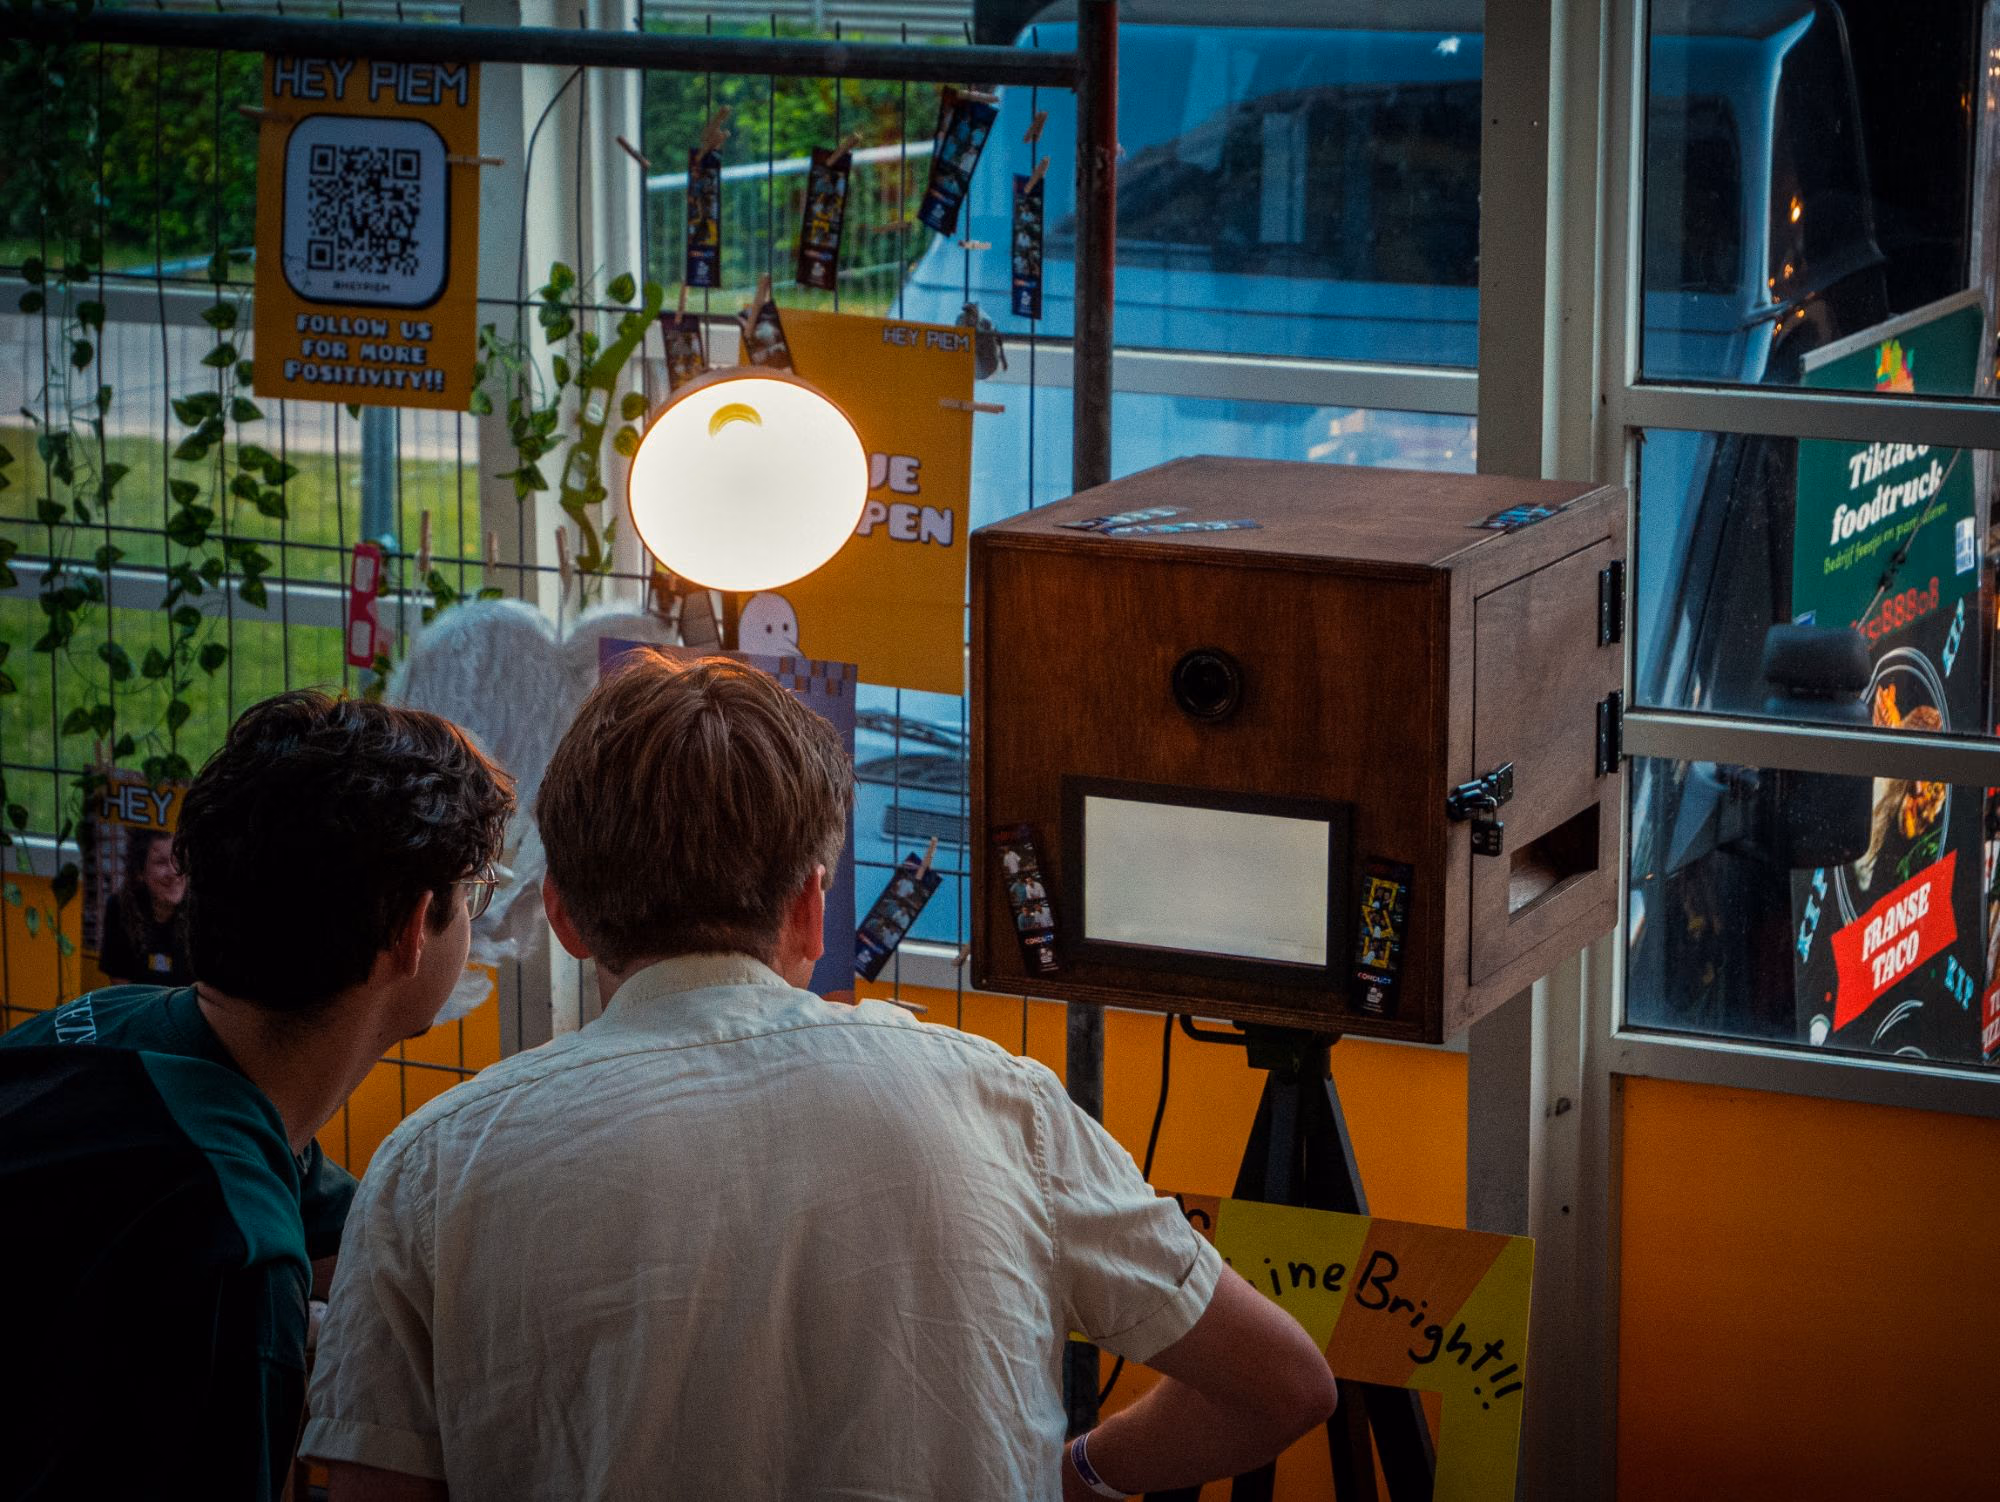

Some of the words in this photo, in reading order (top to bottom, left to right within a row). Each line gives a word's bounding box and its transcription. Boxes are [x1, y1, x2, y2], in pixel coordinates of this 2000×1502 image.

[272, 56, 355, 99] HEY
[369, 61, 469, 107] PIEM
[296, 313, 389, 338] FOLLOW
[400, 321, 433, 341] US
[883, 327, 919, 346] HEY
[302, 339, 348, 359] FOR
[360, 343, 427, 365] MORE
[284, 359, 445, 392] POSITIVITY!!
[856, 500, 954, 546] PEN
[1830, 458, 1943, 545] foodtruck
[103, 785, 173, 825] HEY
[1862, 881, 1931, 963] FRANSE
[1872, 930, 1920, 991] TACO
